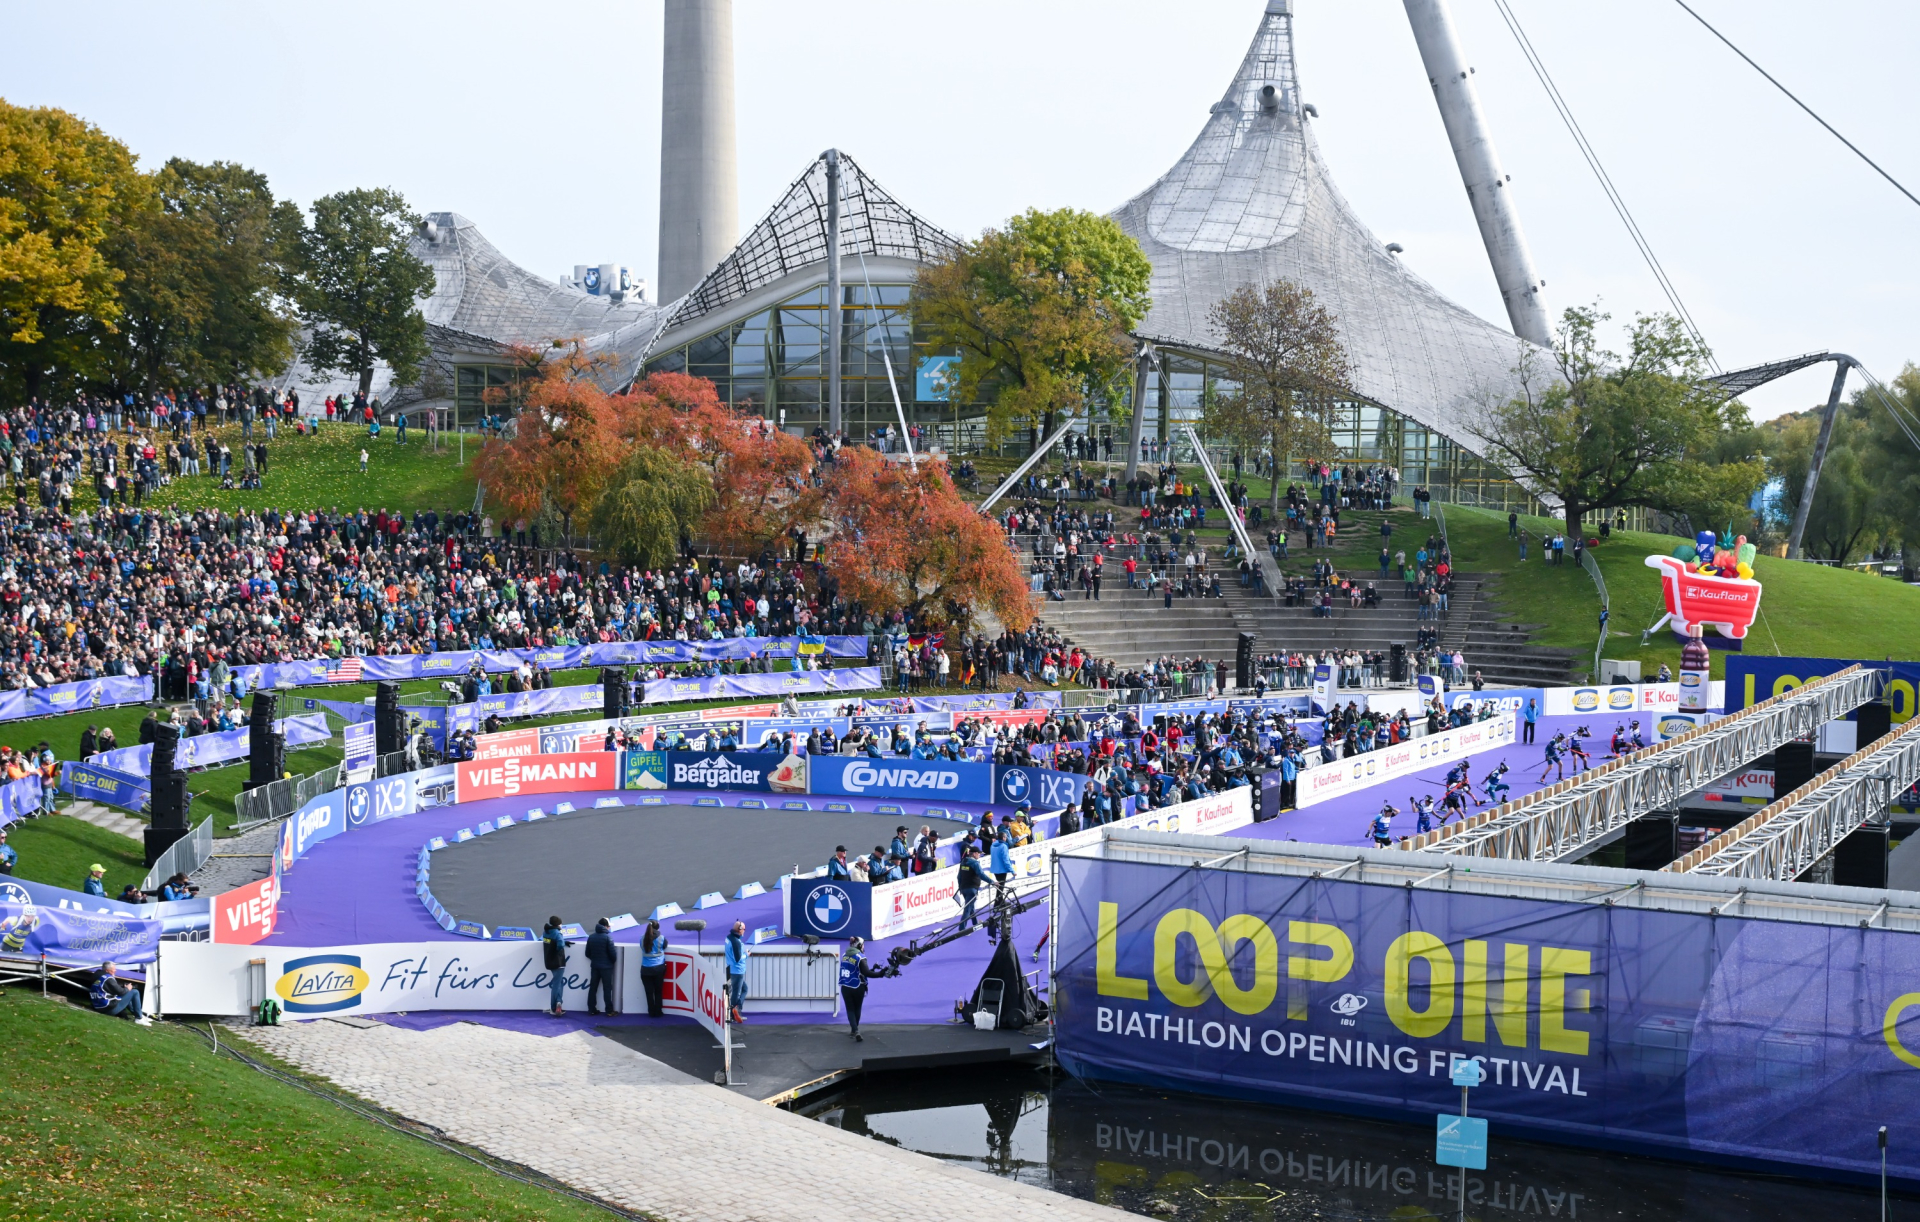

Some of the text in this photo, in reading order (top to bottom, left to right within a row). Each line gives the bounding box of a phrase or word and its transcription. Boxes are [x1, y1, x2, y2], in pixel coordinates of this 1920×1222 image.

[1700, 589, 1748, 602] Kaufland
[535, 652, 564, 661] LOOP ONE
[646, 647, 663, 655] LOOP
[664, 645, 676, 654] ONE
[422, 658, 452, 668] LOOP ONE
[674, 683, 700, 692] LOOP ONE
[1659, 690, 1679, 703] Kau
[480, 701, 506, 712] LOOP ONE
[238, 735, 250, 746] LOO
[473, 744, 531, 760] VIESMANN
[631, 756, 662, 767] GIPFEL
[649, 765, 664, 773] KÄSE
[69, 772, 96, 784] LOOP
[97, 778, 118, 791] ONE
[469, 758, 597, 794] VIESSMANN
[674, 763, 760, 788] Bergader
[842, 761, 959, 792] CONRAD
[1005, 769, 1027, 782] BMW
[375, 779, 406, 816] iX3
[1041, 774, 1075, 806] iX3
[1204, 801, 1232, 821] Kaufland
[297, 805, 331, 853] CONRAD
[812, 887, 846, 901] BMW
[907, 881, 954, 909] Kaufland
[226, 881, 276, 935] VIESS
[68, 915, 128, 931] SPORTS.
[87, 928, 150, 945] CULTURE.
[500, 930, 526, 939] LOOP ONE
[67, 937, 131, 954] MUNICH.
[380, 956, 428, 992] Fit
[435, 957, 498, 998] fürs
[1096, 900, 1591, 1056] LOOP ONE
[1340, 1018, 1356, 1027] IBU
[1096, 1006, 1251, 1054] BIATHLON
[1260, 1028, 1418, 1075] OPENING
